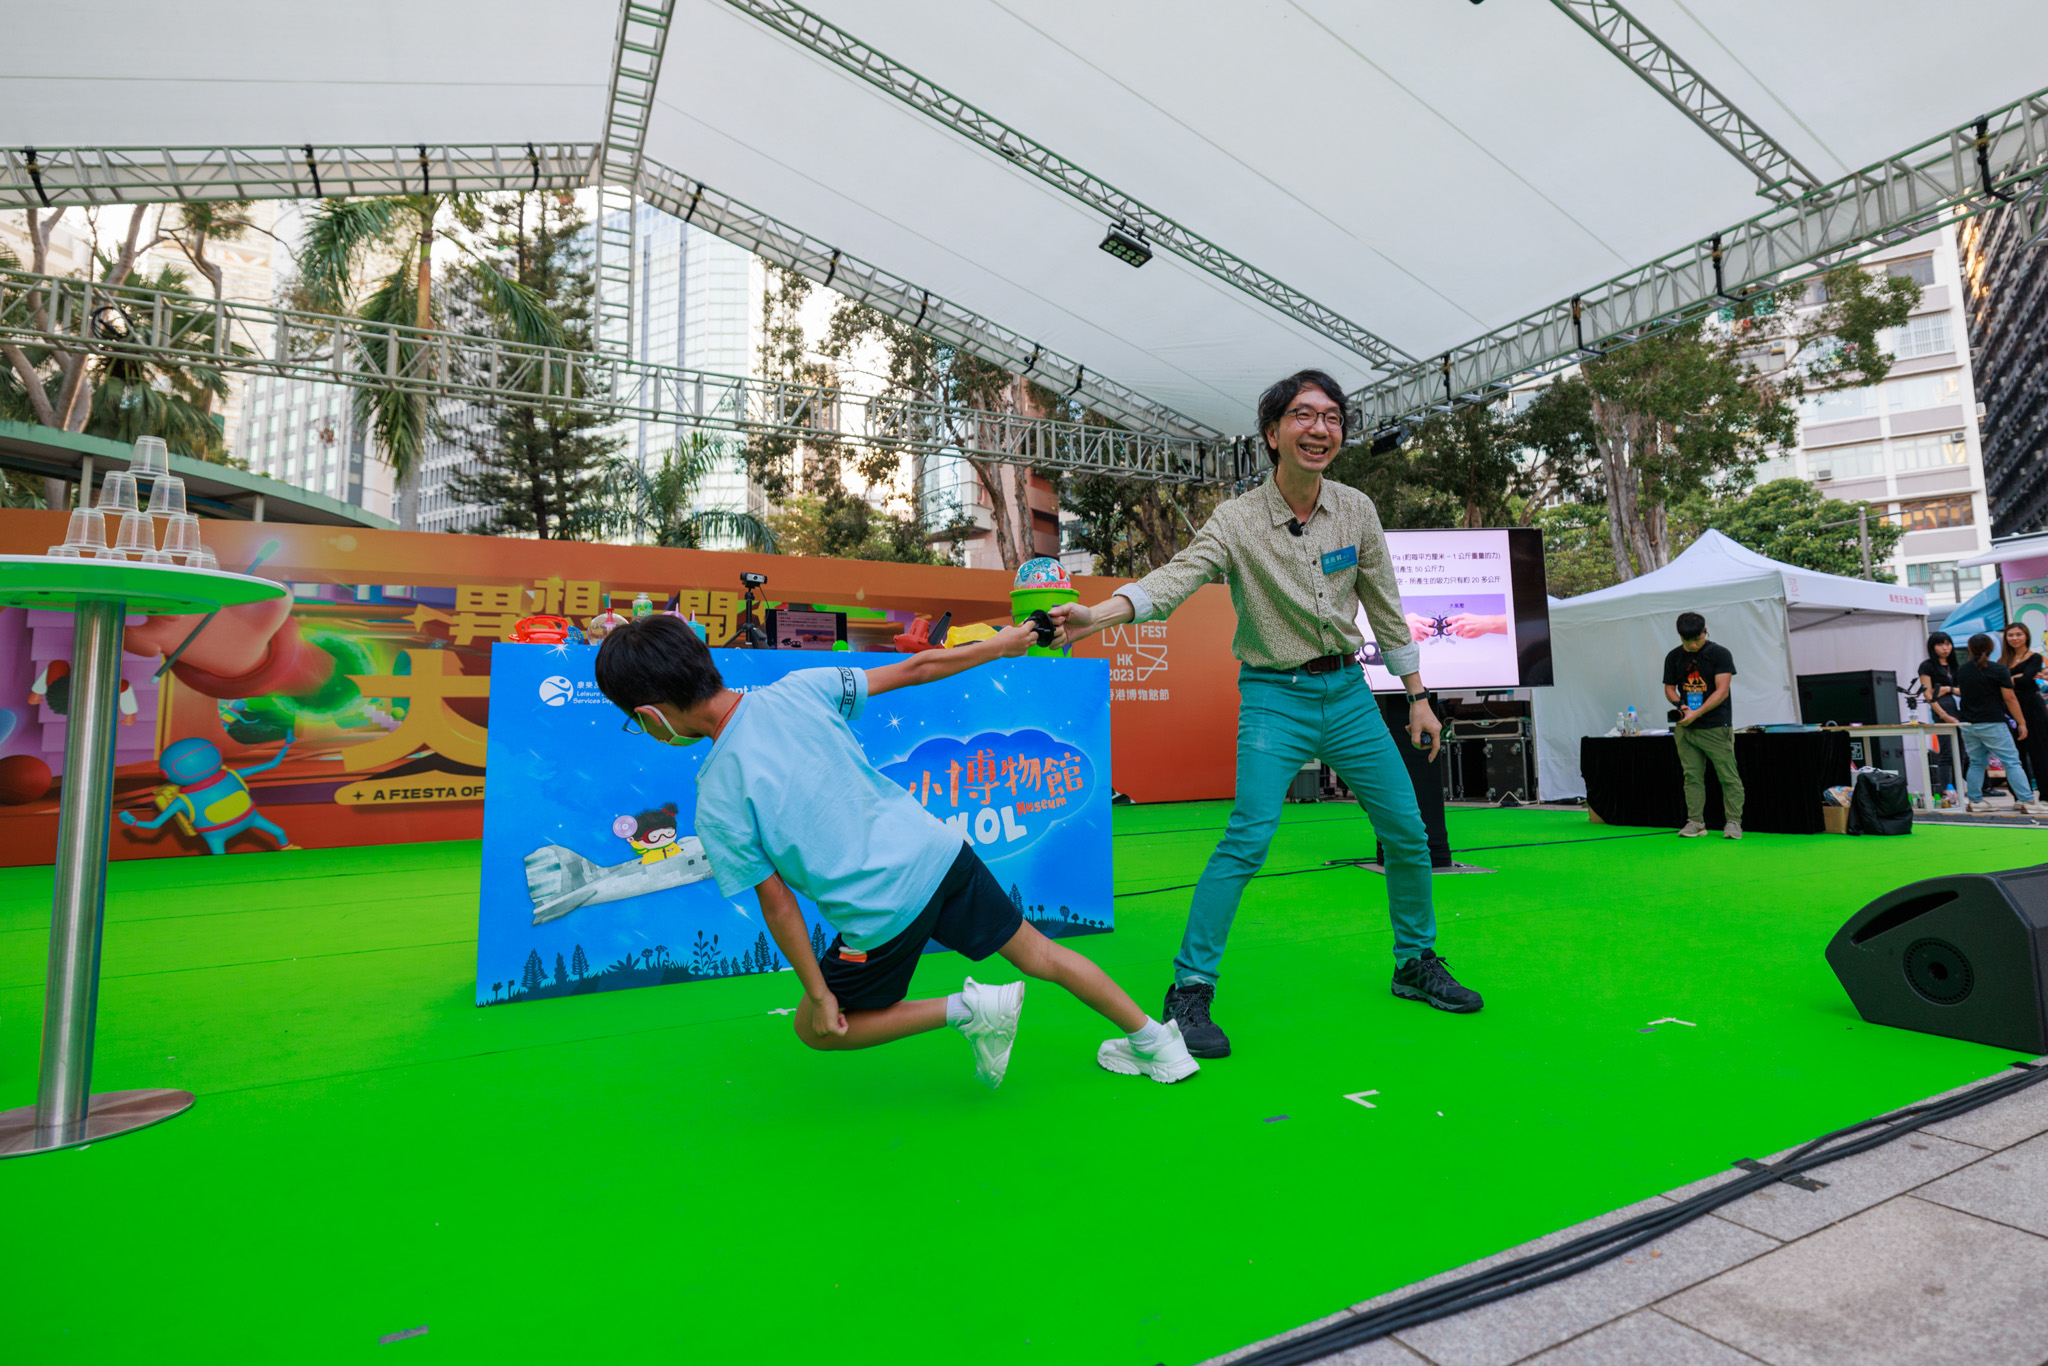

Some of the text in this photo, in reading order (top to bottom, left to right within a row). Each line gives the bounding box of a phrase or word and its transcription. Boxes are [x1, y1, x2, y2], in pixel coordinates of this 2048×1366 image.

[1140, 625, 1168, 638] FEST
[1116, 653, 1134, 667] HK
[373, 785, 484, 801] A FIESTA OF
[1016, 796, 1067, 817] Museum
[946, 805, 1028, 847] KOL
